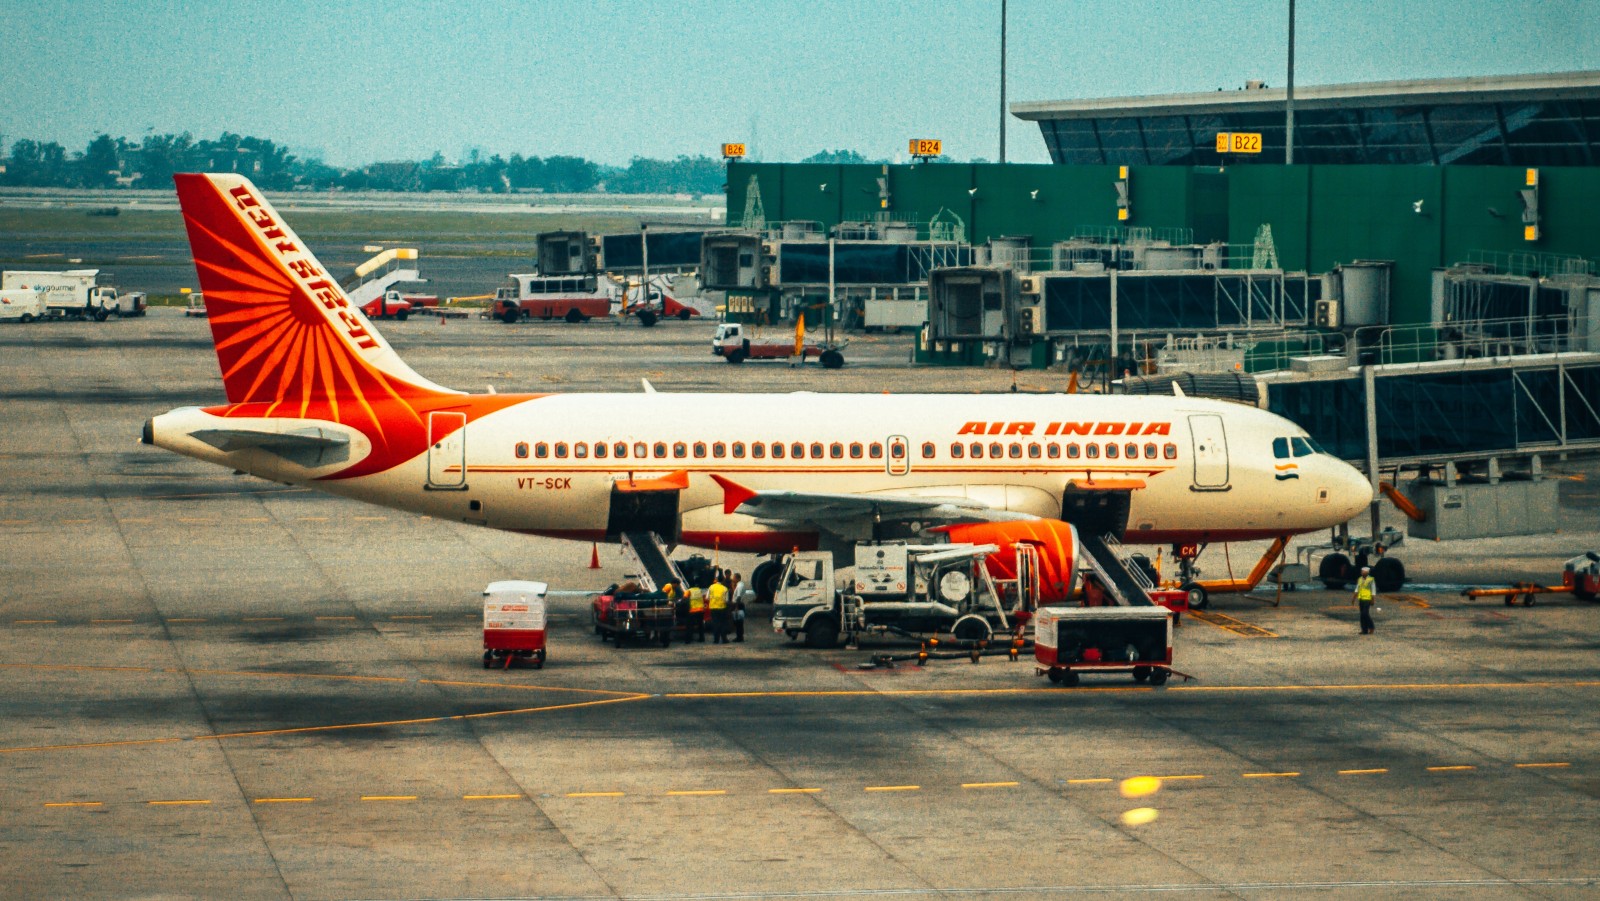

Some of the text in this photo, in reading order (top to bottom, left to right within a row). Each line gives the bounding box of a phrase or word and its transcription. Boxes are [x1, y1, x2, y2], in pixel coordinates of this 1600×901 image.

[920, 141, 939, 153] B24
[1235, 135, 1259, 150] B22
[727, 144, 744, 155] B26
[230, 184, 381, 350] एअर इंडिया
[957, 421, 1172, 436] AIR INDIA
[517, 477, 572, 490] VT-SCK
[1182, 546, 1195, 556] CK
